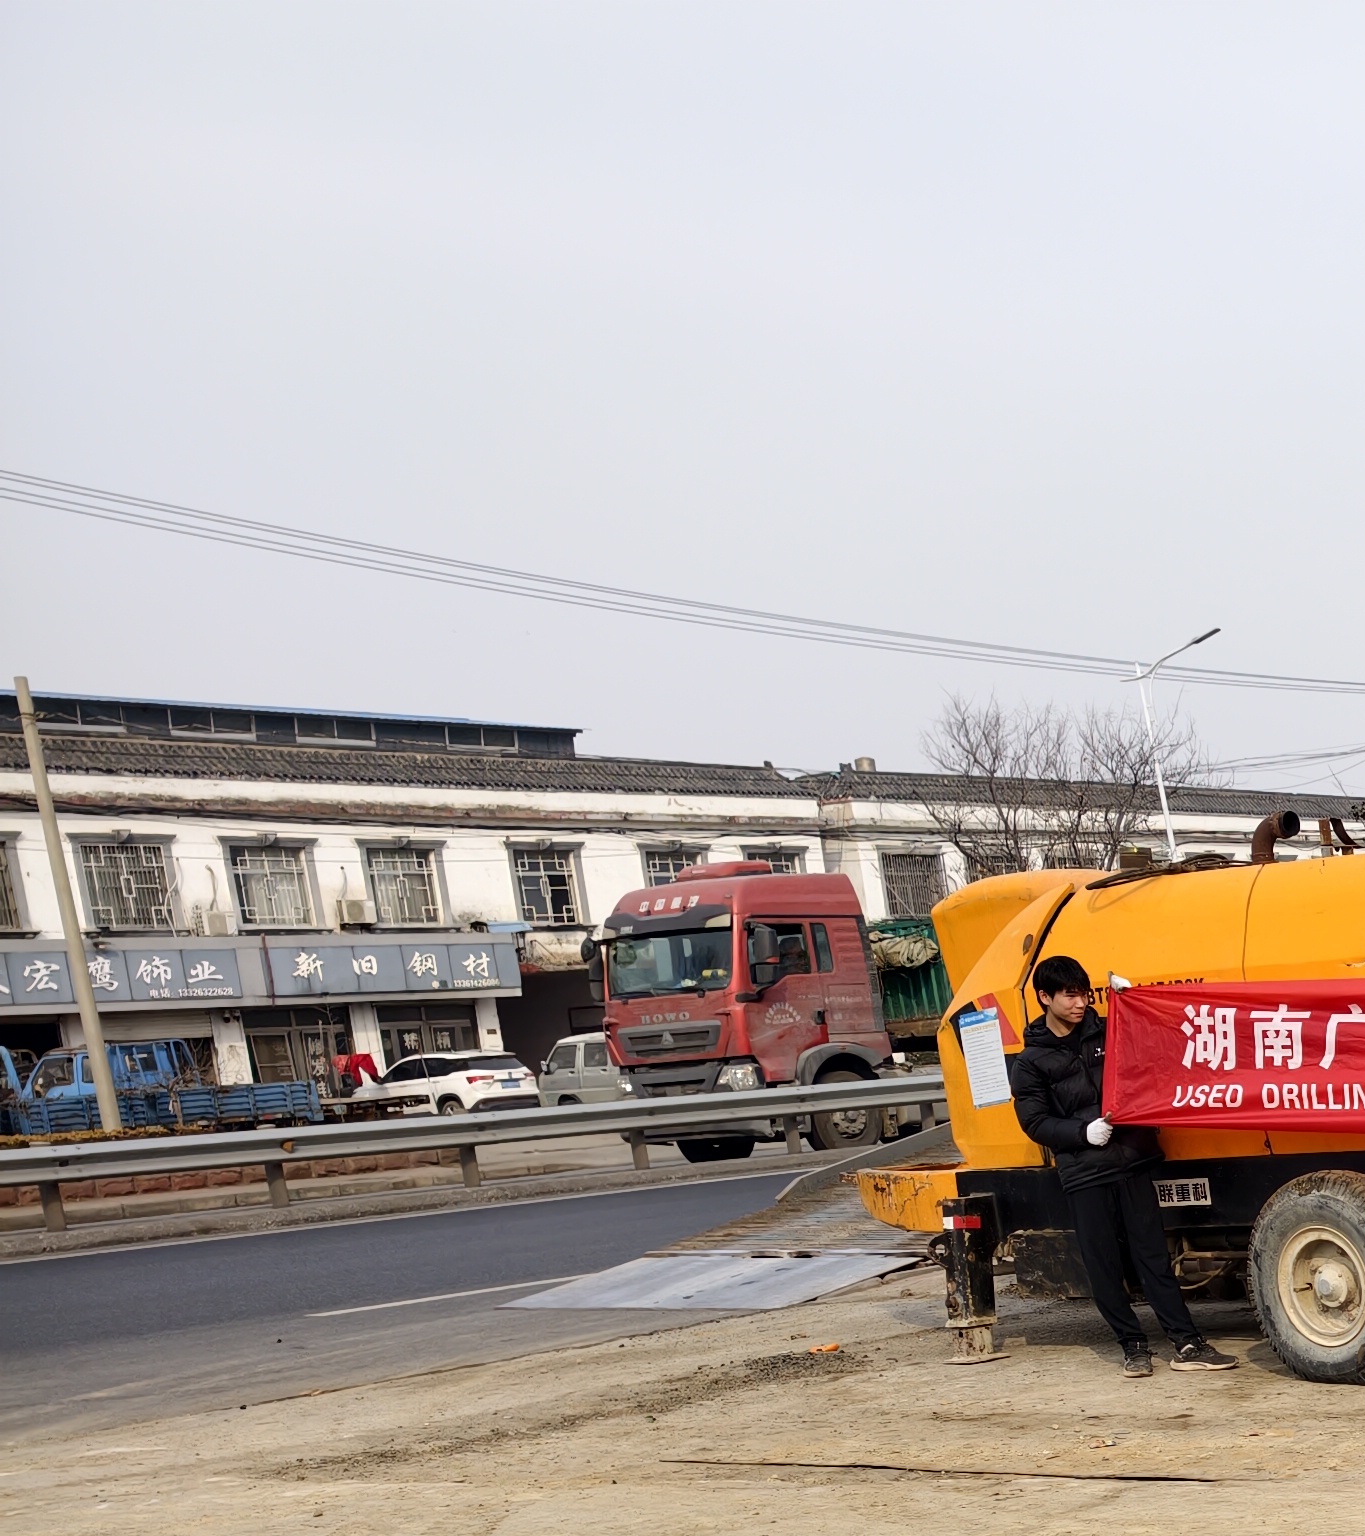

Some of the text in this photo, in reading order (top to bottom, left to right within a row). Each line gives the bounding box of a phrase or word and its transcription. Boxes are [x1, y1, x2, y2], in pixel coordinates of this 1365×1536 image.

[0, 956, 224, 994] 宏鹰饰业
[292, 951, 491, 982] 新旧钢材
[640, 1010, 690, 1025] HOWO
[1172, 1084, 1244, 1109] USED
